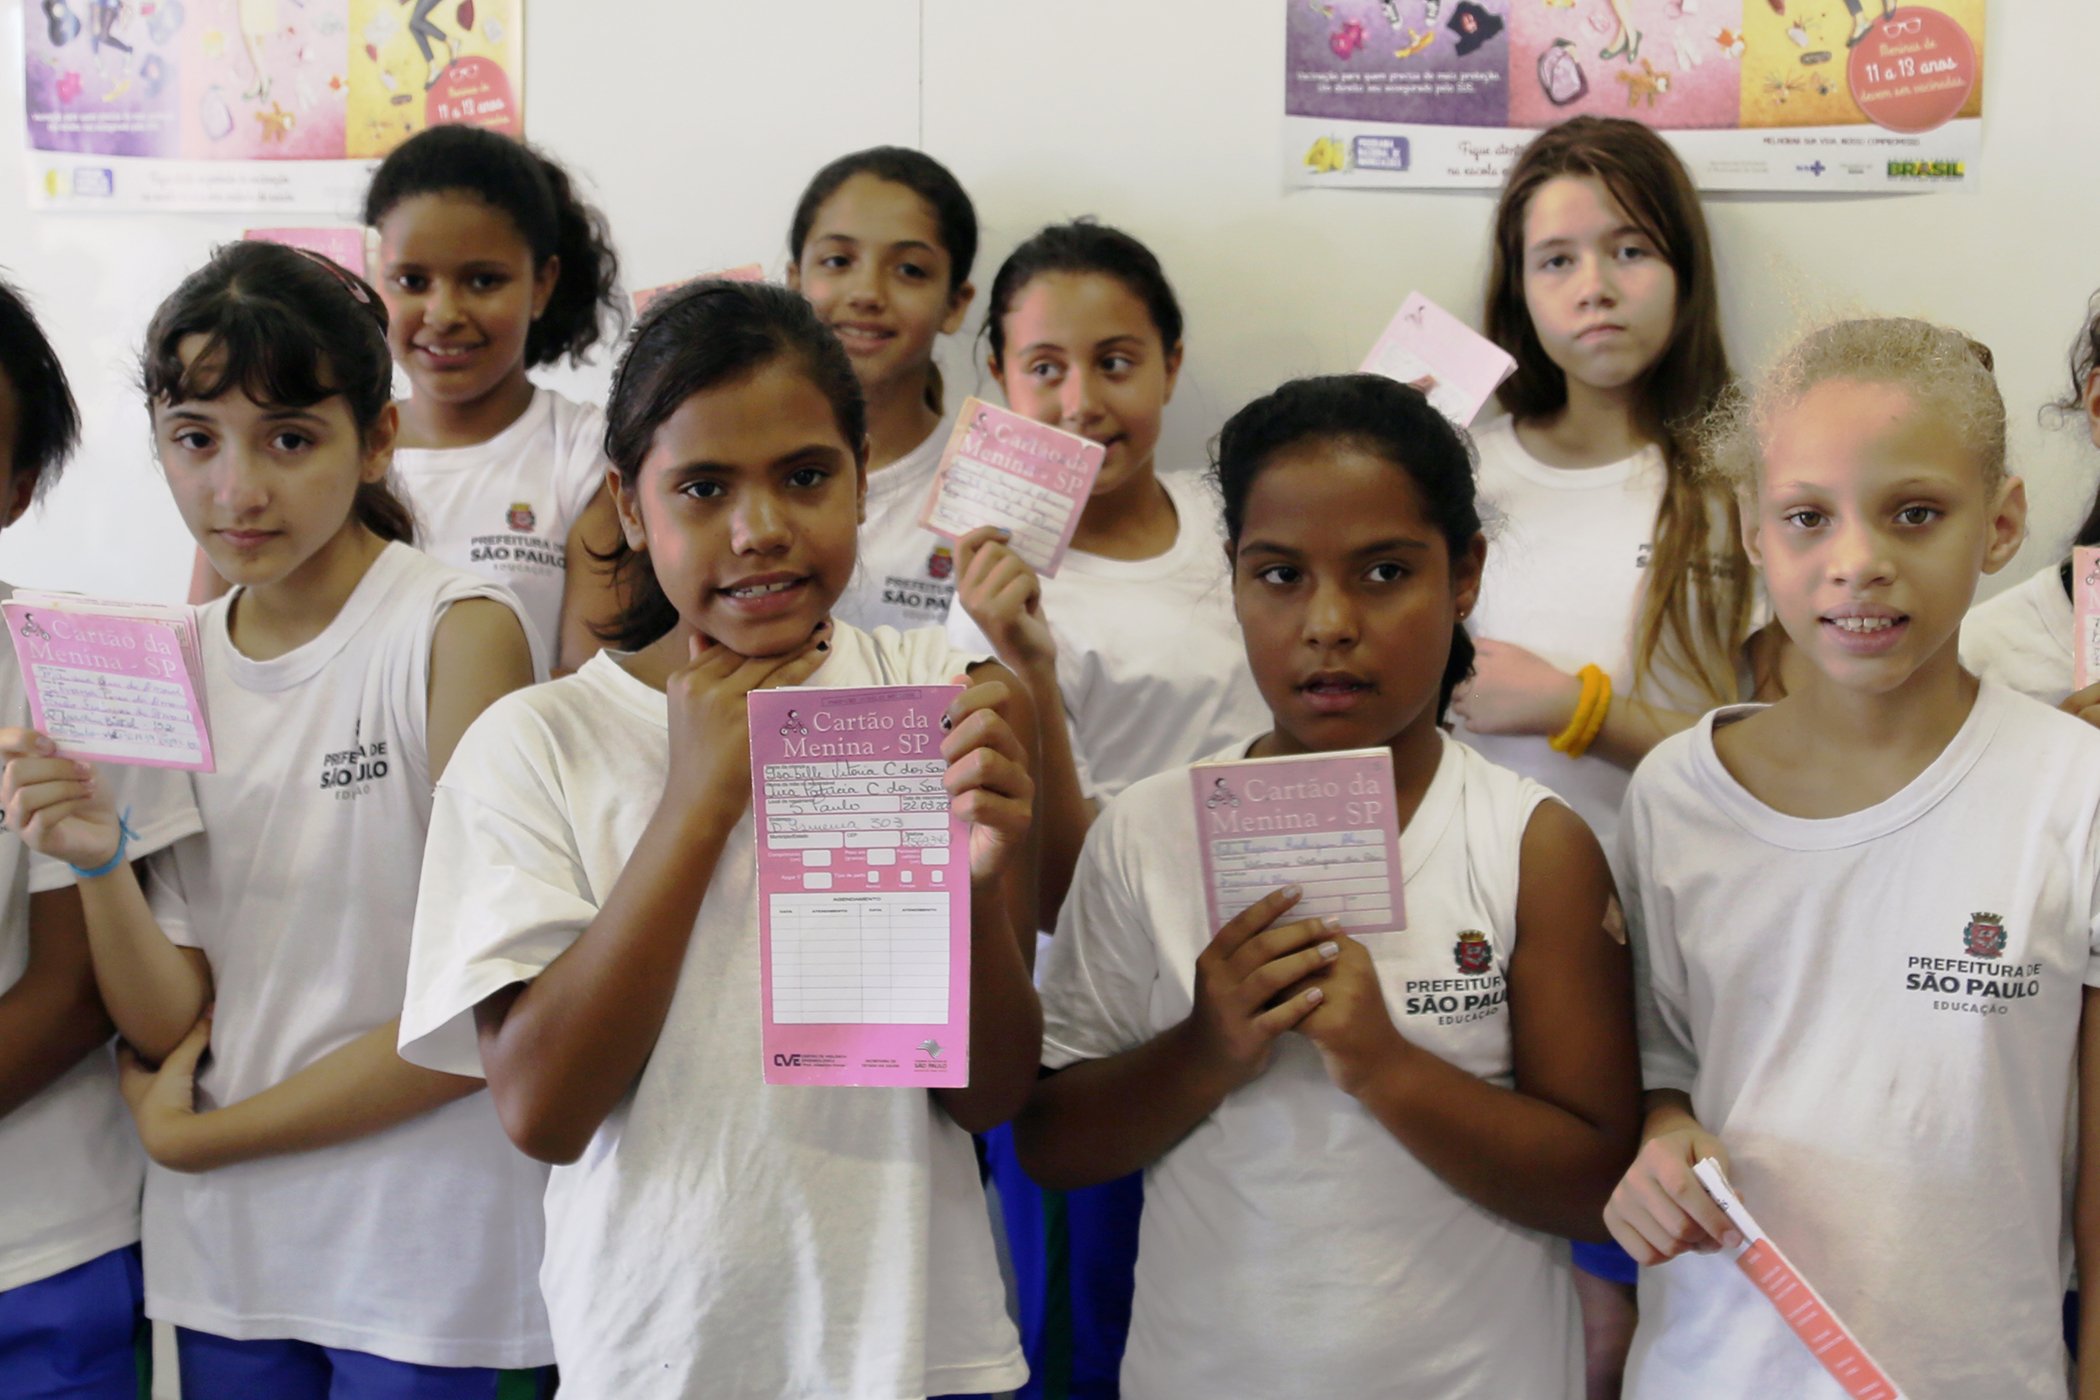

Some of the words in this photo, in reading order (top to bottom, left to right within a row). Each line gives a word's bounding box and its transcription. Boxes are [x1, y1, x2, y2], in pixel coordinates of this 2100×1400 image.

[1866, 63, 1879, 83] 11
[1884, 68, 1896, 81] a
[1898, 57, 1915, 78] 13
[1920, 57, 1958, 75] anos
[1886, 159, 1965, 178] BRASIL
[1055, 470, 1084, 493] SP
[470, 546, 510, 562] SÃO
[513, 549, 567, 569] PAULO
[52, 619, 137, 650] Cartão
[144, 633, 173, 656] da
[29, 640, 124, 671] Menina
[144, 655, 178, 680] SP
[813, 711, 895, 732] Cartão
[902, 708, 929, 729] da
[783, 736, 875, 758] Menina
[899, 733, 930, 754] SP
[883, 761, 897, 776] C
[867, 781, 880, 796] C
[1244, 779, 1339, 802] Cartão
[1348, 772, 1382, 796] da
[1210, 808, 1319, 834] Menina
[1345, 801, 1383, 825] SP
[1907, 956, 2023, 978] PREFEITURA
[2027, 963, 2042, 977] DE
[1906, 972, 1961, 993] SÃO
[1966, 979, 2040, 999] PAULO
[1406, 994, 1459, 1015] SÃO
[1933, 1000, 2009, 1016] EDUCAÇÃO
[1438, 1007, 1499, 1026] EDUCAÇÃO
[773, 1053, 802, 1067] CVE
